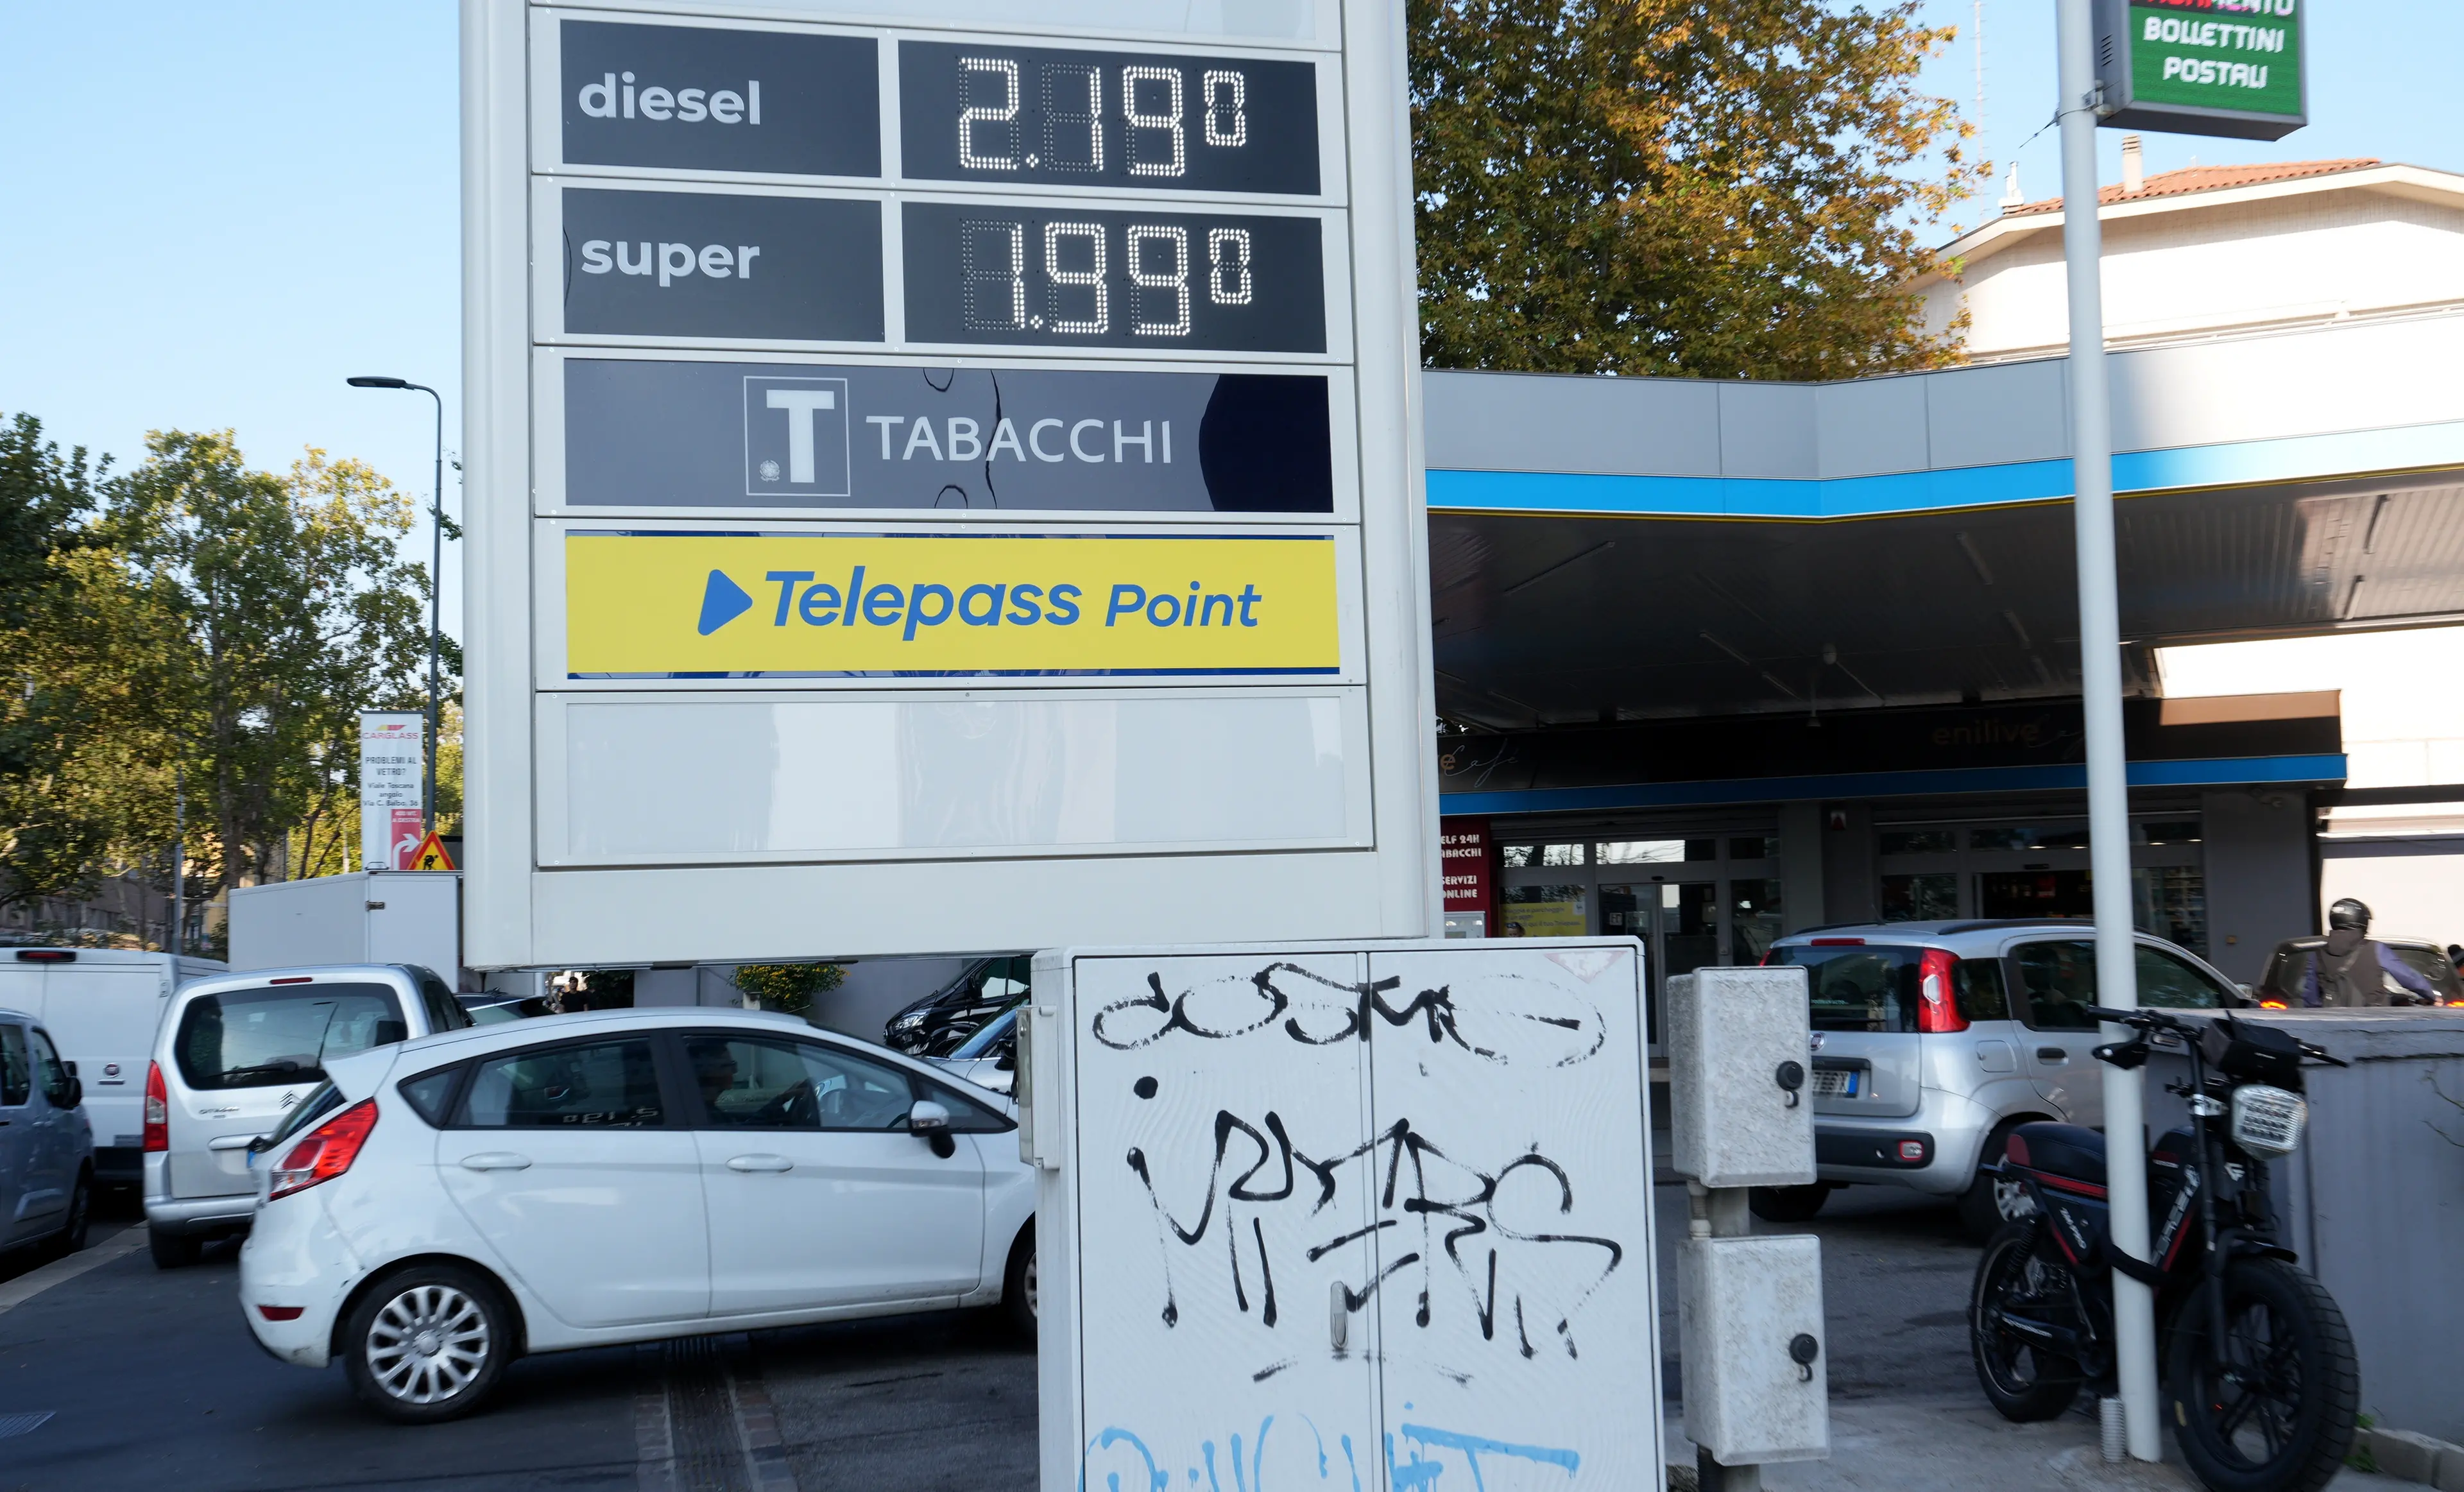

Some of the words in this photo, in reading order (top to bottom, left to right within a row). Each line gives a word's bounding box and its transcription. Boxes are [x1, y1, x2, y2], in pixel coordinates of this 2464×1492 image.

[2143, 16, 2286, 53] BOLLETTINI
[578, 71, 760, 125] diesel
[581, 239, 760, 287] super
[865, 415, 1172, 464] TABACCHI
[764, 565, 1083, 641] Telepass
[1104, 580, 1262, 628] Point
[1441, 835, 1457, 845] ELF
[1459, 834, 1480, 844] 24H
